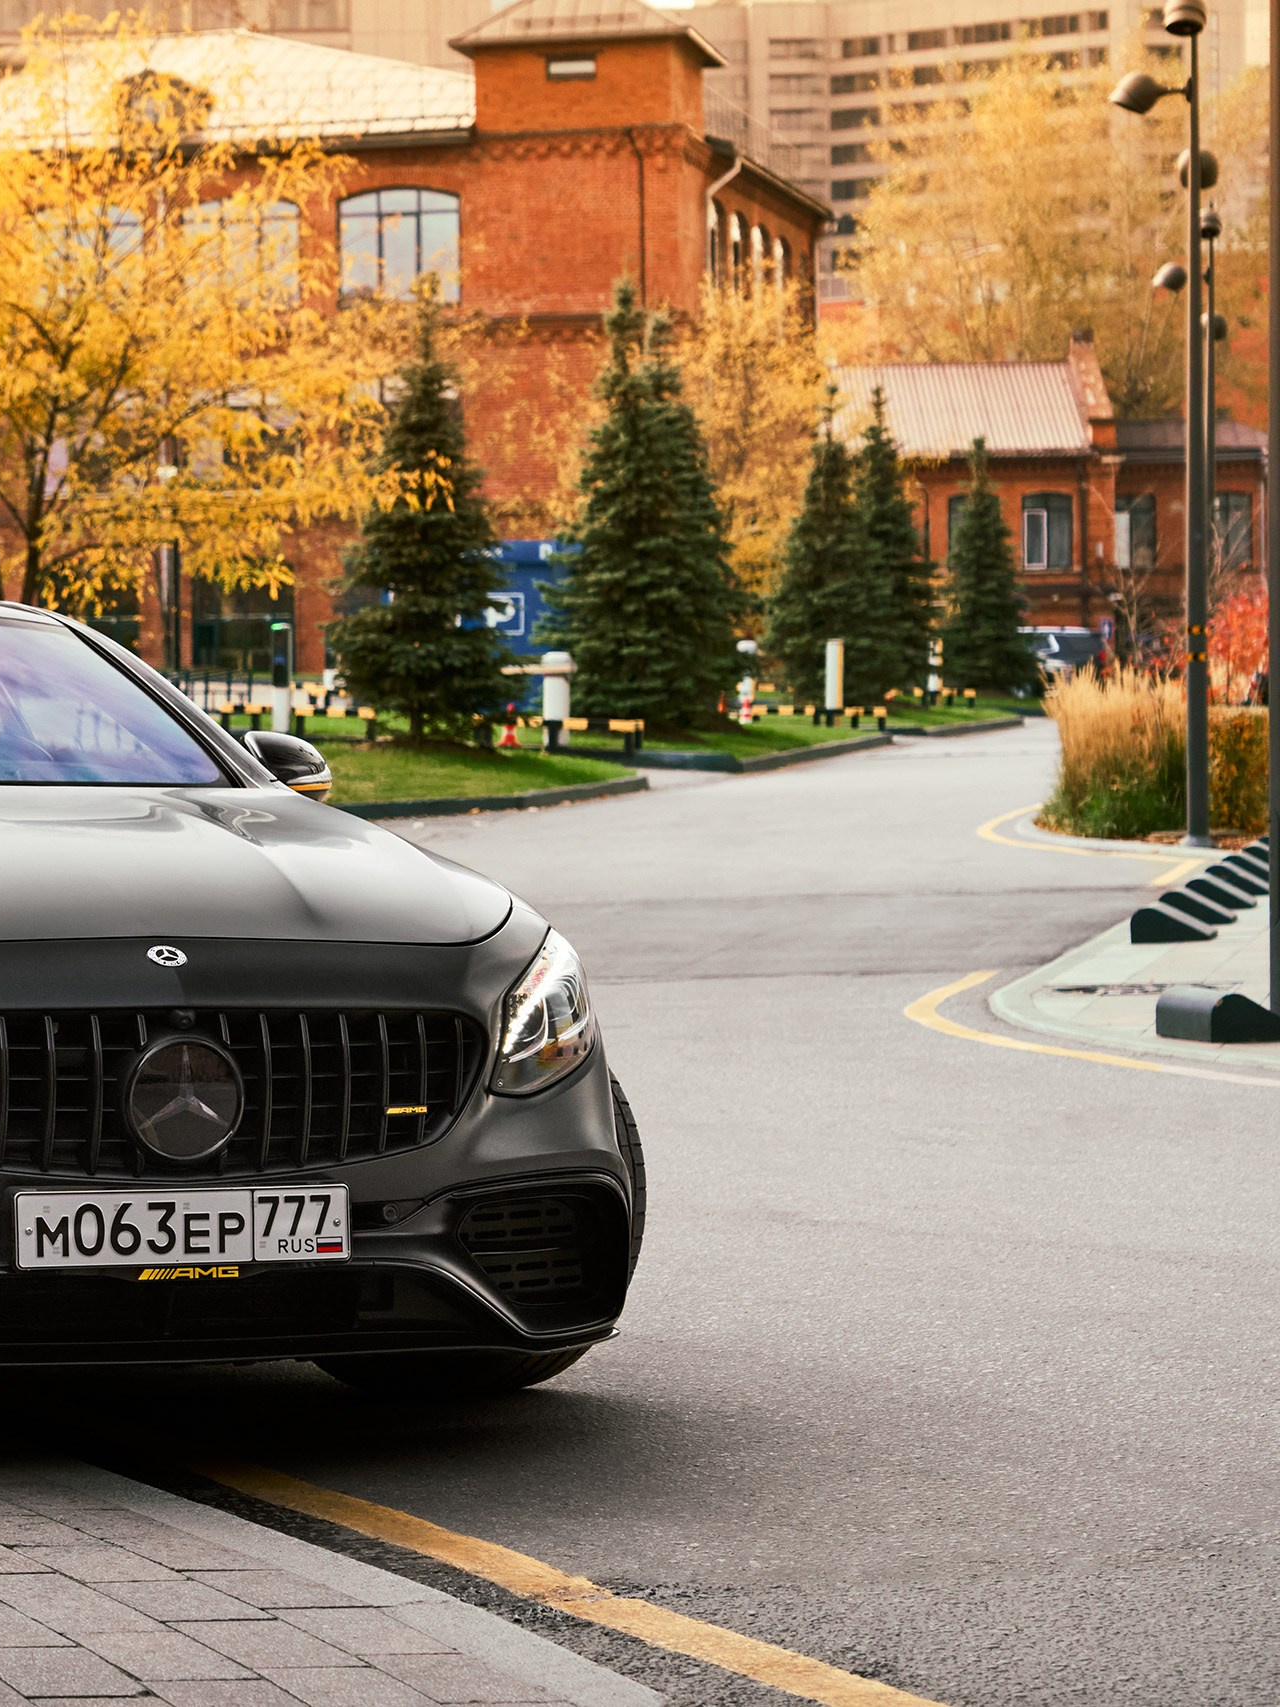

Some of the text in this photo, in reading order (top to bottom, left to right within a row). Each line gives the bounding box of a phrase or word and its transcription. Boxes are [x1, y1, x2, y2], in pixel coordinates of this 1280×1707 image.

[400, 1106, 427, 1114] AMG
[257, 1194, 332, 1238] 777
[278, 1239, 315, 1254] RUS
[172, 1266, 239, 1280] AMG
